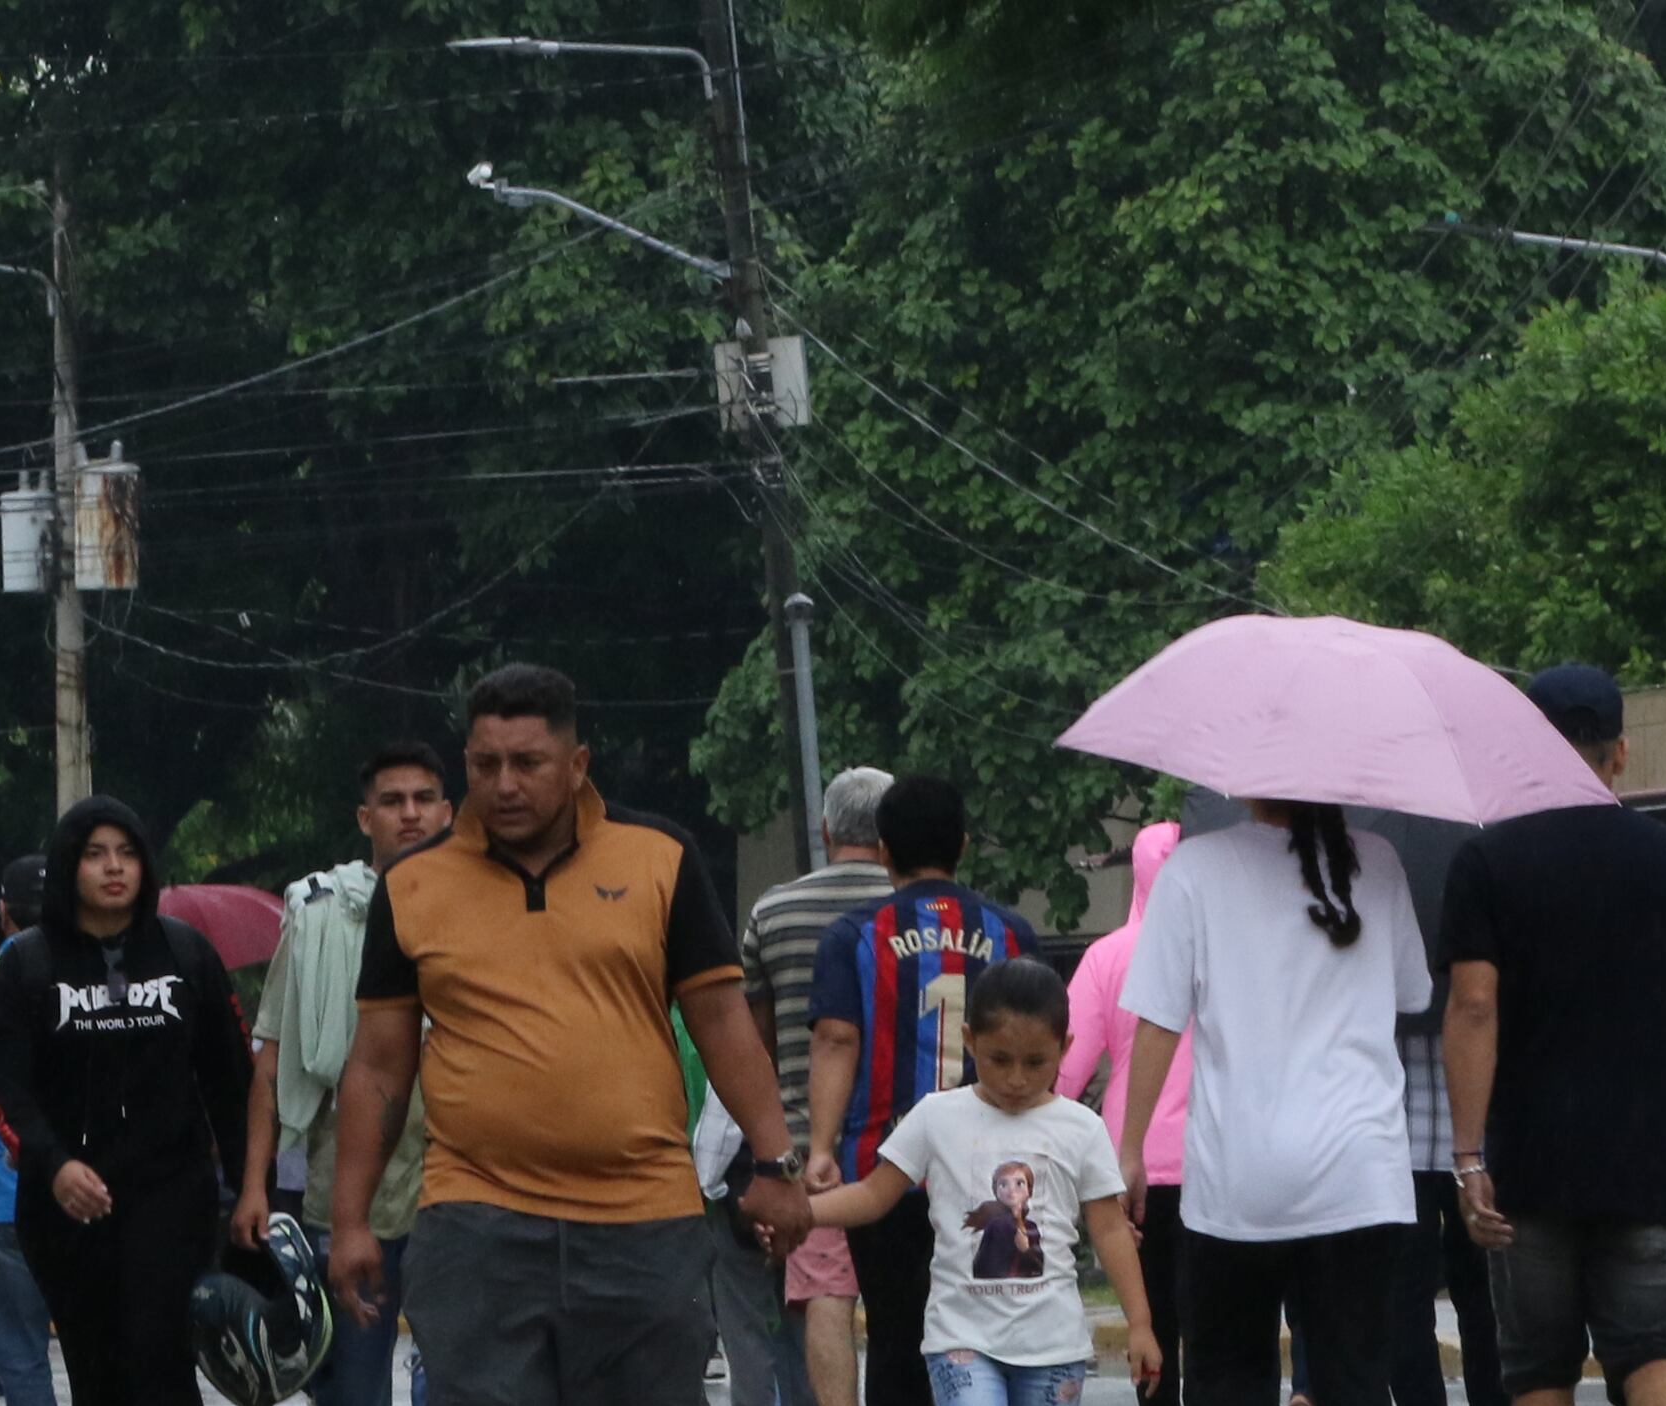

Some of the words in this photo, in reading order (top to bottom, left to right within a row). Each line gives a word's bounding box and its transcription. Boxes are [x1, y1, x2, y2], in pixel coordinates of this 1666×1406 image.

[888, 926, 994, 962] ROSALÍA
[51, 974, 184, 1031] PUROSE
[136, 1014, 165, 1028] TOUR
